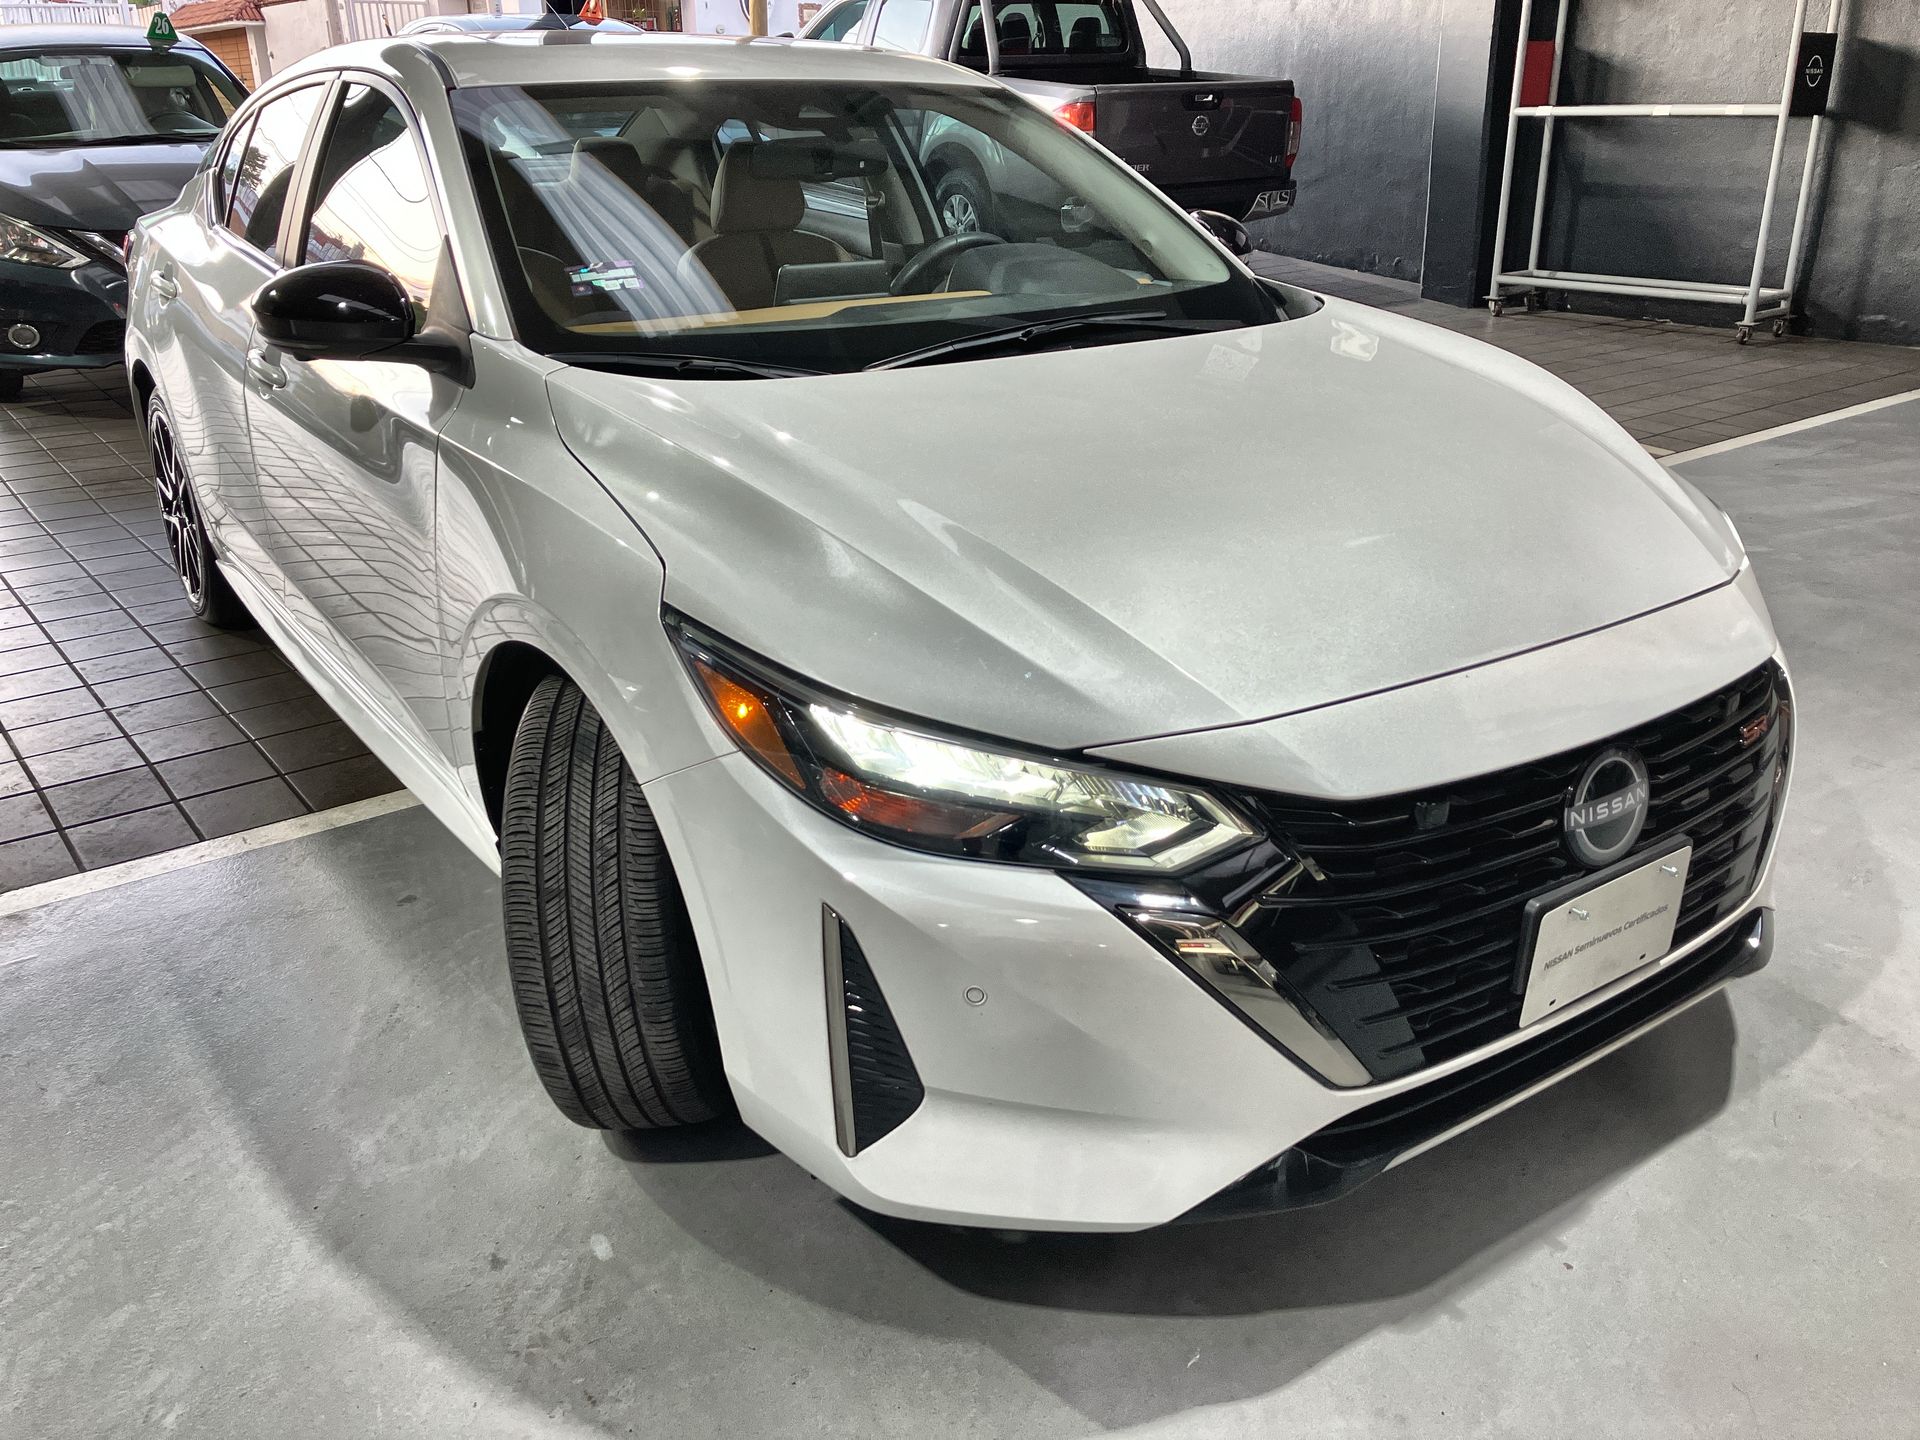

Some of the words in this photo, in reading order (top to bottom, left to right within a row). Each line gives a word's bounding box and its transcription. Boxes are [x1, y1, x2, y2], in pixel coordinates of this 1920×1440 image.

[154, 16, 170, 35] 26
[1570, 783, 1646, 827] NISSAN
[1543, 947, 1574, 971] NISSAN
[1574, 926, 1622, 955] Seminuevos
[1623, 904, 1669, 931] Certificados
